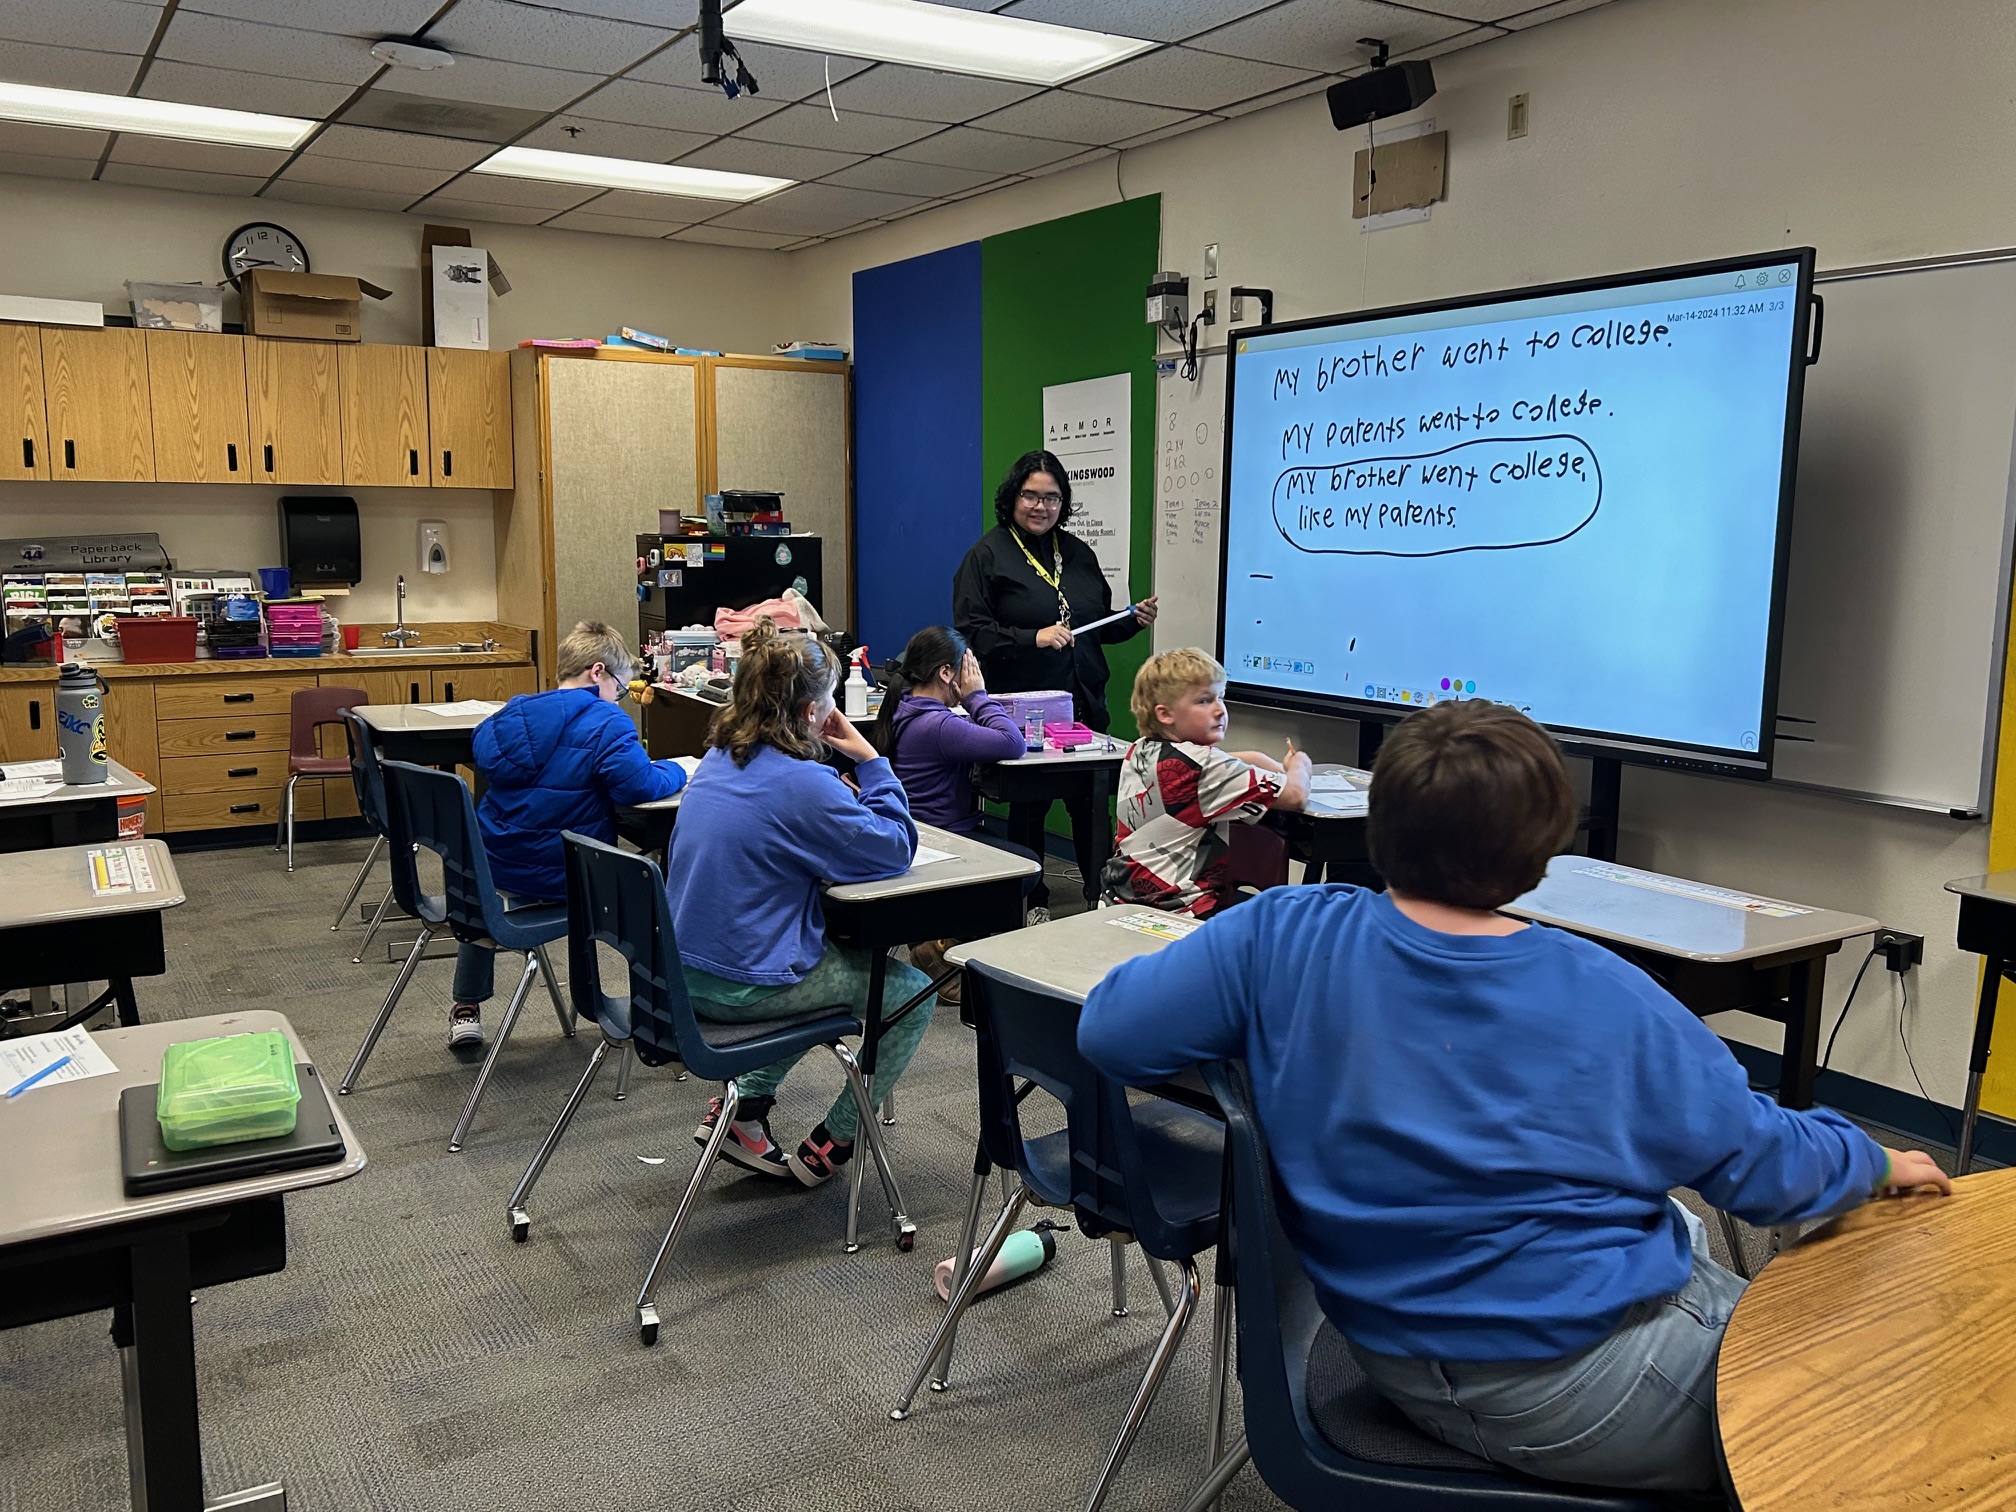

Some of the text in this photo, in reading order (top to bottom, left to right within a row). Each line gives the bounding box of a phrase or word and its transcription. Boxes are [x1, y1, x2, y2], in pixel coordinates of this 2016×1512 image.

[246, 236, 254, 245] 11
[257, 232, 268, 240] 12
[276, 235, 280, 244] 1
[285, 244, 294, 253] 2
[1667, 300, 1784, 322] Mar-14-2024 11:32 AM 3/3
[1317, 343, 1426, 392] brother
[1442, 337, 1510, 368] went
[1526, 330, 1560, 357] to
[1050, 417, 1111, 434] ARMOR
[1168, 411, 1177, 431] 8
[1326, 417, 1406, 448] parents
[1419, 406, 1470, 433] went
[1472, 402, 1500, 430] to
[1330, 463, 1412, 491] brother
[1421, 464, 1479, 492] went
[1212, 500, 1219, 508] 2
[1299, 504, 1335, 531] like
[71, 542, 142, 554] Paperback
[23, 550, 43, 561] 44
[83, 554, 132, 564] Library
